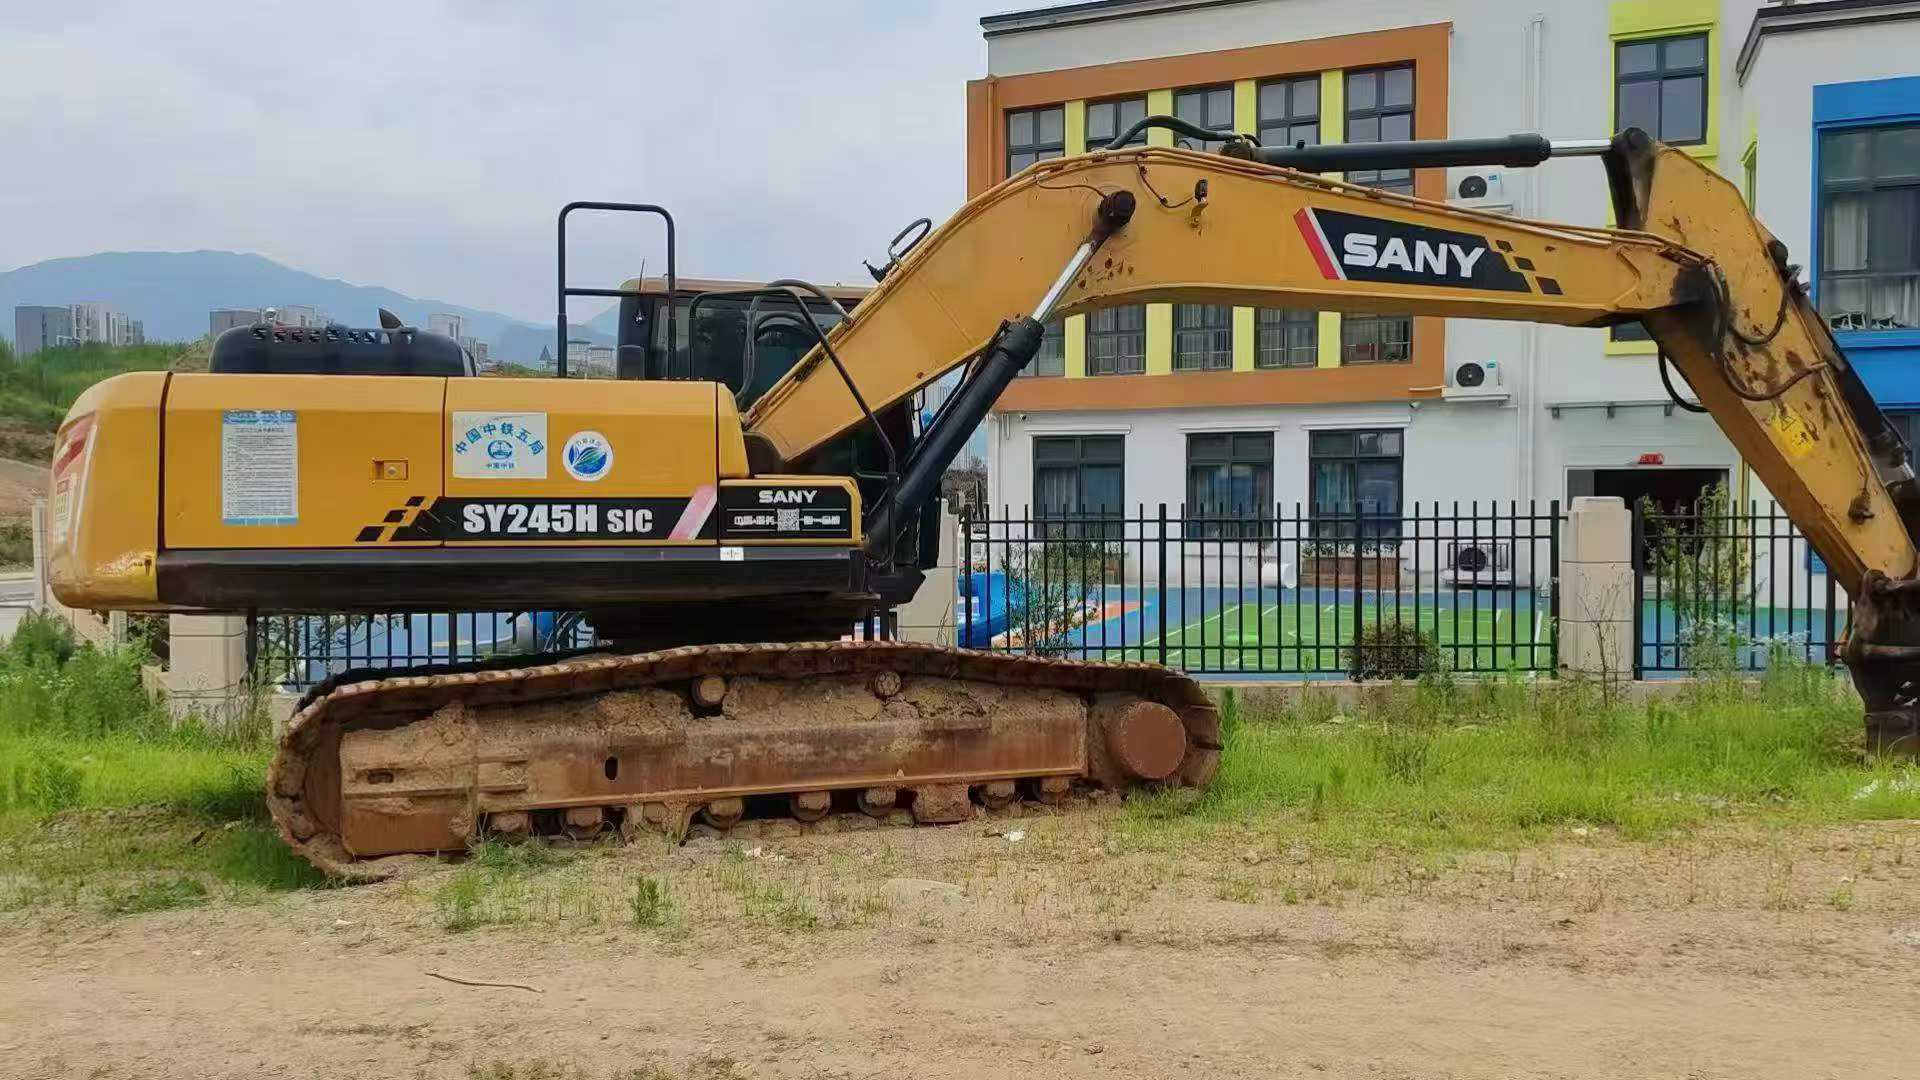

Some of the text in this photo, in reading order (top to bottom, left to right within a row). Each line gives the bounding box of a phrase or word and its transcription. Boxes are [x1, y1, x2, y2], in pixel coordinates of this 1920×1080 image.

[1343, 232, 1486, 278] SANY
[455, 422, 544, 455] 中国中铁五局
[758, 490, 818, 503] SANY
[462, 504, 653, 533] SY245H SIC
